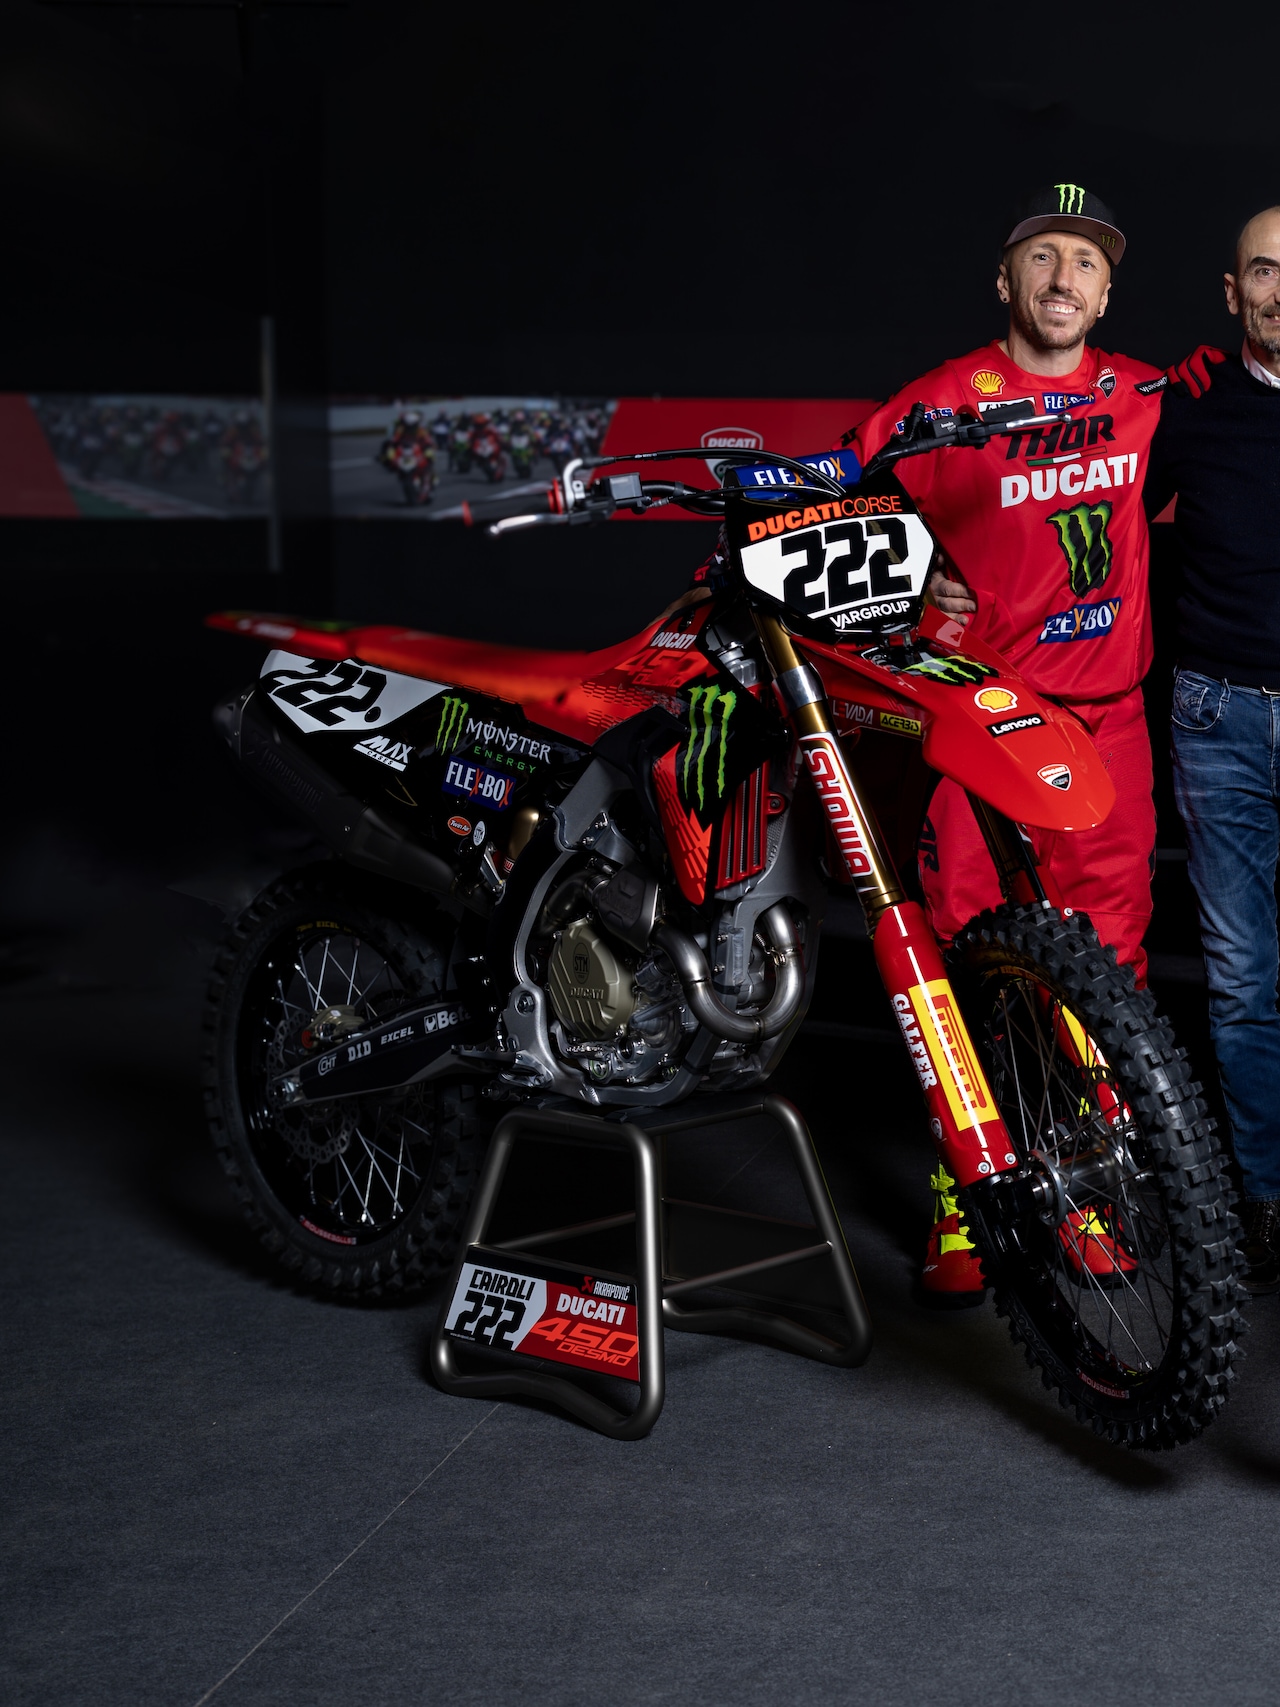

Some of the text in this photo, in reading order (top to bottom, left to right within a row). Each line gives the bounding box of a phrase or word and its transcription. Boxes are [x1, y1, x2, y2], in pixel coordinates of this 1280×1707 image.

[707, 436, 757, 449] DUCATI
[1000, 413, 1117, 460] THOR
[1001, 452, 1138, 508] DUCATI
[780, 516, 913, 613] 222
[829, 599, 912, 630] VARGROUP
[650, 631, 698, 650] DUCATI
[259, 659, 388, 727] 222
[832, 699, 874, 726] LEVADA
[991, 716, 1042, 736] Lenovo
[360, 734, 413, 764] MAX
[366, 750, 394, 766] CASES
[473, 745, 537, 774] ENERGY
[445, 760, 514, 808] FLEX-BOX
[1041, 765, 1068, 777] DUCATI
[803, 746, 875, 878] SHOWA
[573, 956, 589, 974] STM
[380, 1026, 415, 1046] EXCEL
[892, 992, 938, 1090] GALFER
[468, 1268, 536, 1301] CAIROLI
[453, 1289, 527, 1351] 222
[556, 1292, 627, 1326] DUCATI
[530, 1316, 640, 1357] 450
[557, 1341, 632, 1367] DESMO
